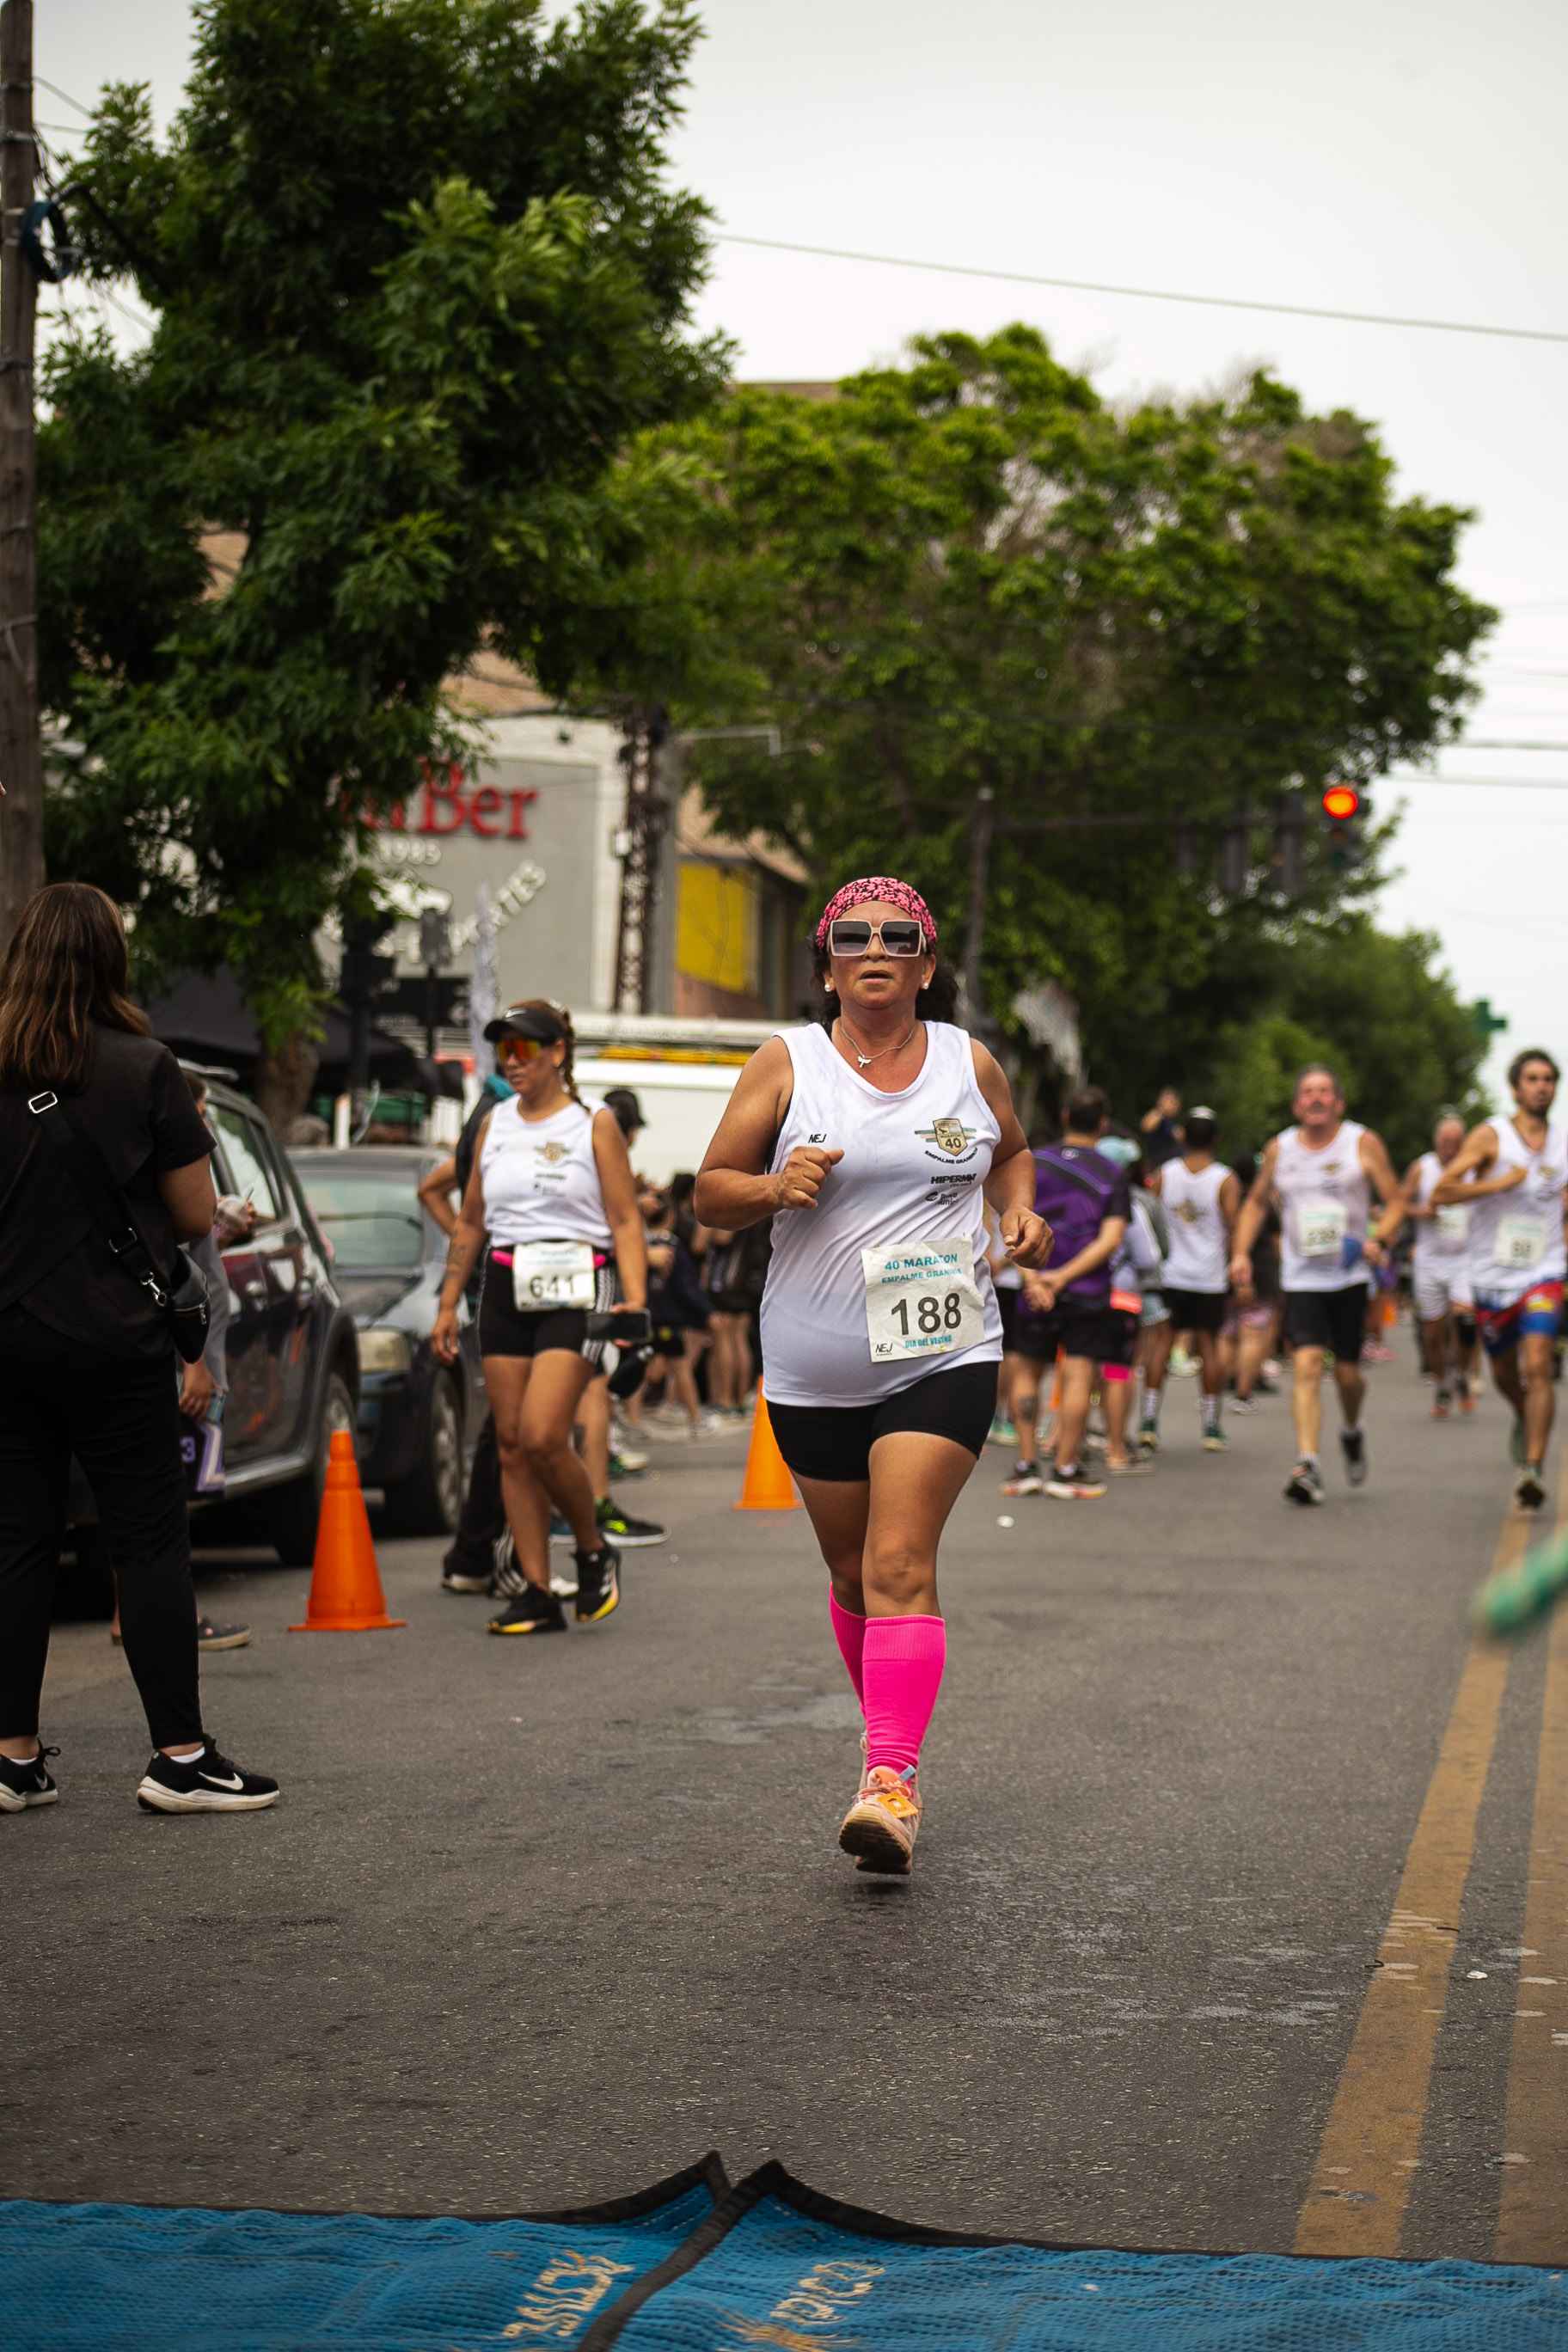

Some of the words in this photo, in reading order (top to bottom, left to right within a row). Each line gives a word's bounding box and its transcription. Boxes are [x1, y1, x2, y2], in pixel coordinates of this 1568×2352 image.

[808, 1134, 827, 1143] NEJ
[946, 1137, 962, 1148] 40
[924, 1149, 955, 1164] EMPALME
[885, 1260, 900, 1271] 40
[903, 1253, 959, 1268] MARATON
[881, 1272, 924, 1283] EMPALME
[529, 1274, 575, 1298] 641
[891, 1292, 962, 1335] 188
[929, 1335, 952, 1345] VECINO
[875, 1343, 893, 1353] NEJ
